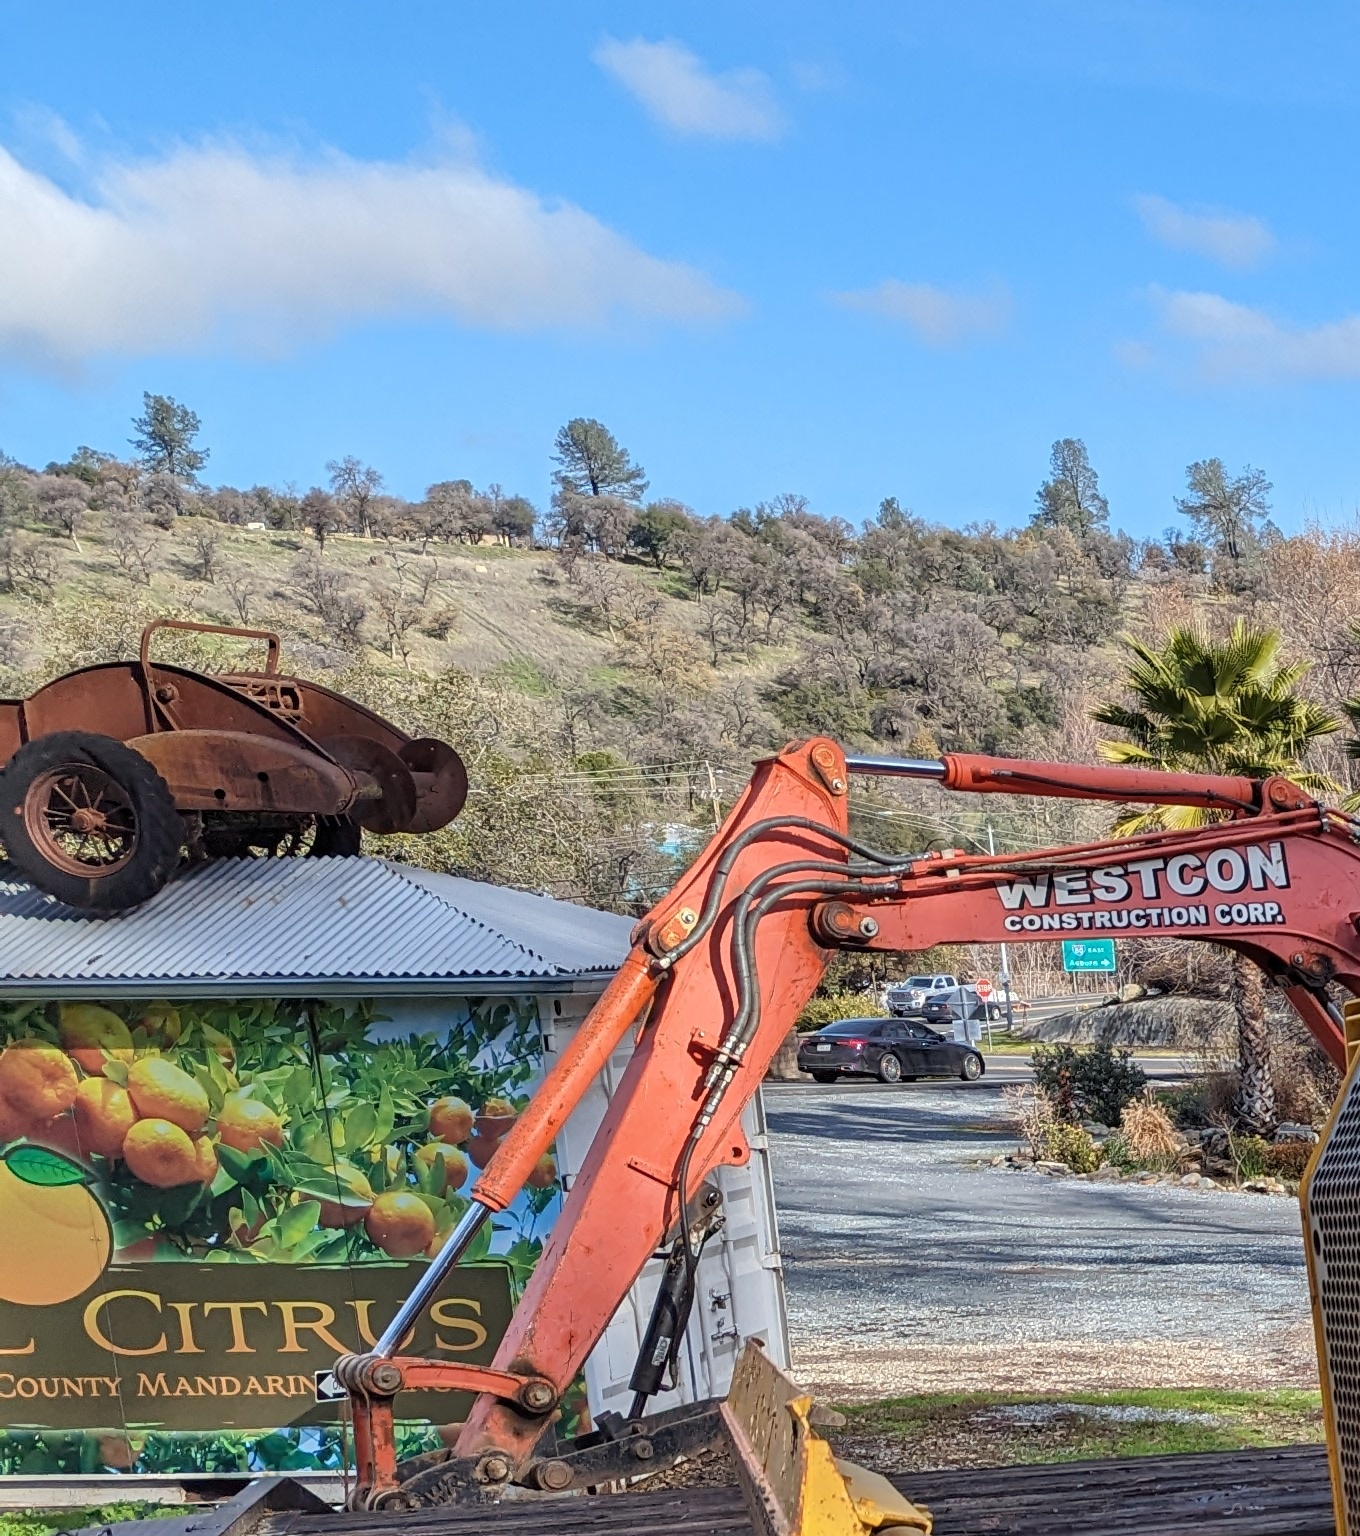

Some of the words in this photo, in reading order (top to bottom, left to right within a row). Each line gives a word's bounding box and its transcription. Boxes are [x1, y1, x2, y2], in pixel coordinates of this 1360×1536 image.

[995, 842, 1290, 909] WESTCON
[1003, 904, 1208, 931] CONSTRUCTION
[1214, 902, 1285, 924] CORP.
[83, 1289, 488, 1356] CITRUS
[0, 1373, 122, 1398] COUNTY
